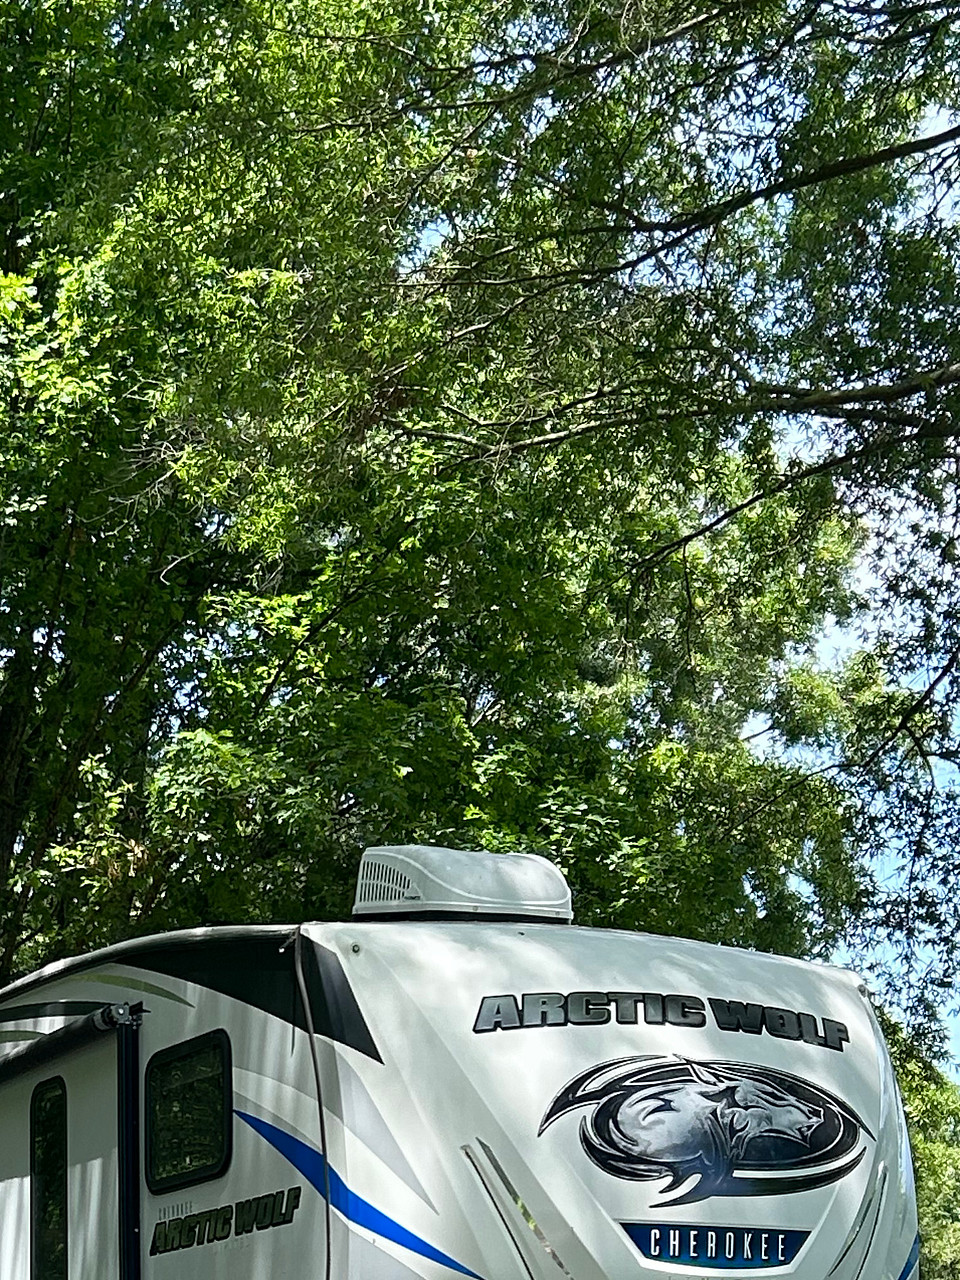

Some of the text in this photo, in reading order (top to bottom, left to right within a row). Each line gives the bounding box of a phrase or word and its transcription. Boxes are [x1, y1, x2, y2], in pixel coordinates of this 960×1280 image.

[473, 991, 851, 1053] ARCTIC WOLF
[149, 1186, 302, 1257] ARCTIC WOLF
[650, 1228, 786, 1262] CHEROKEE
